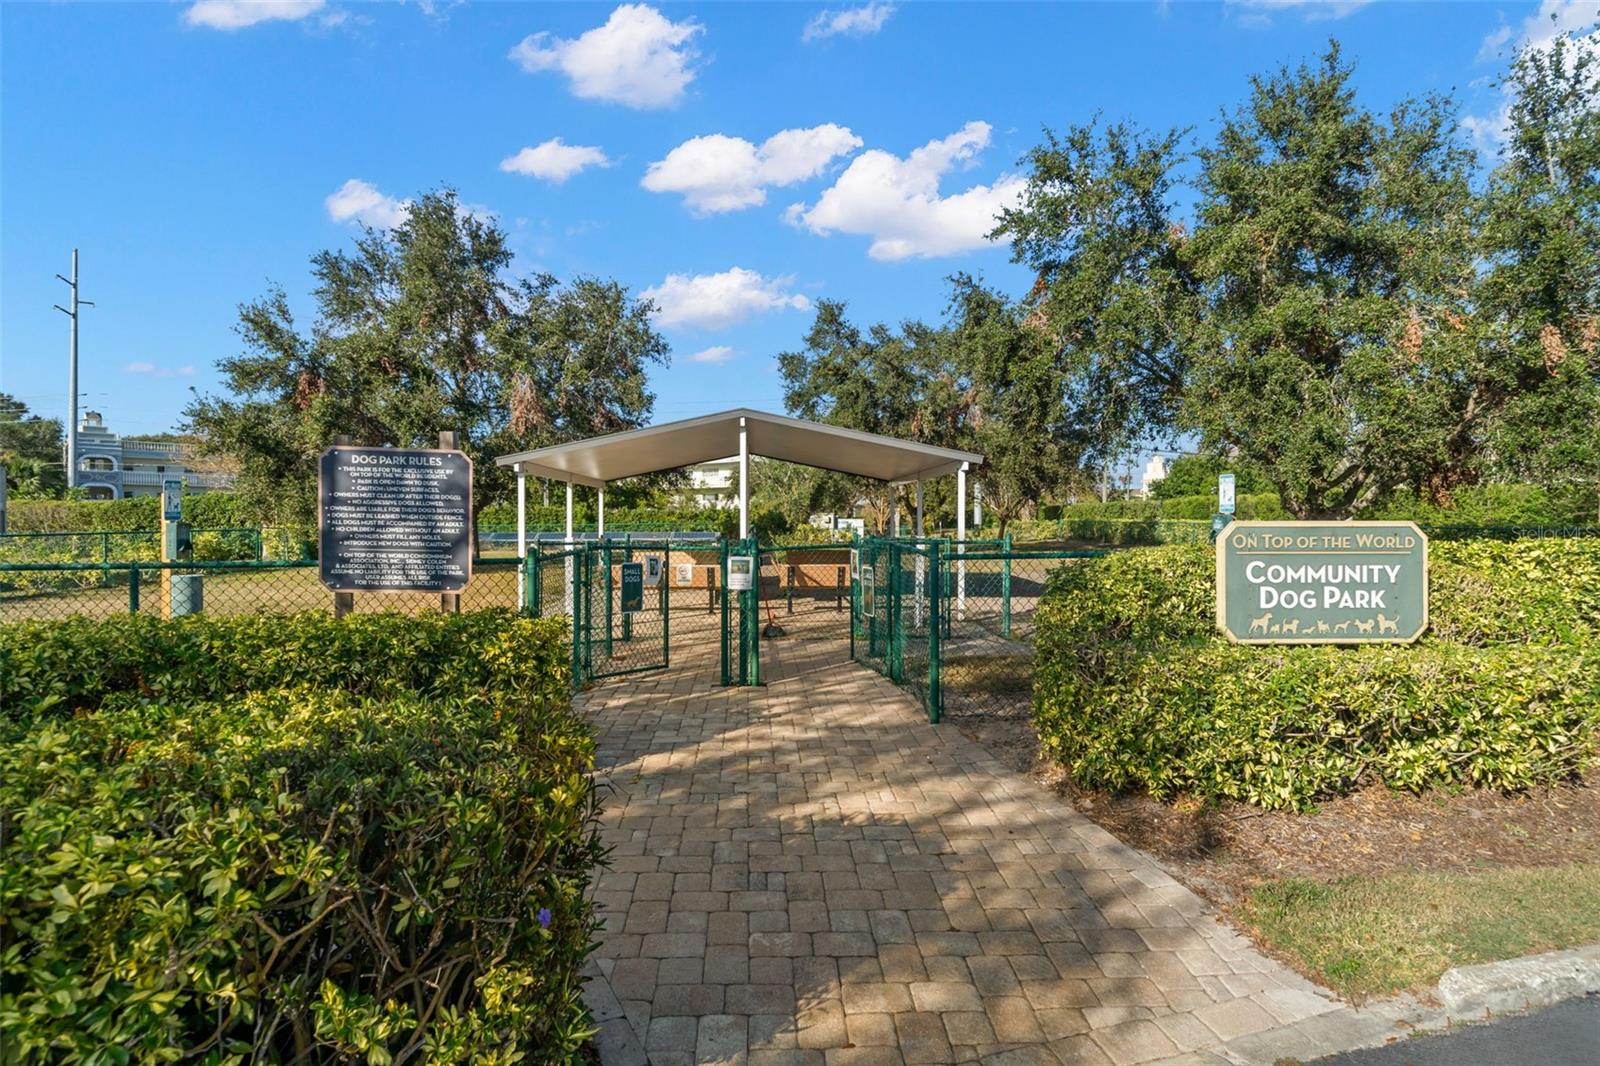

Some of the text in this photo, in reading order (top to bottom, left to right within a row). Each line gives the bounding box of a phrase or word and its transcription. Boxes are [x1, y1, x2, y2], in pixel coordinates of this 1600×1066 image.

[352, 454, 442, 466] DOG PARK RULES
[1232, 534, 1416, 548] ON TOP OF THE WORLD
[1246, 560, 1401, 584] COMMUNITY
[1260, 586, 1386, 608] DOG PARK
